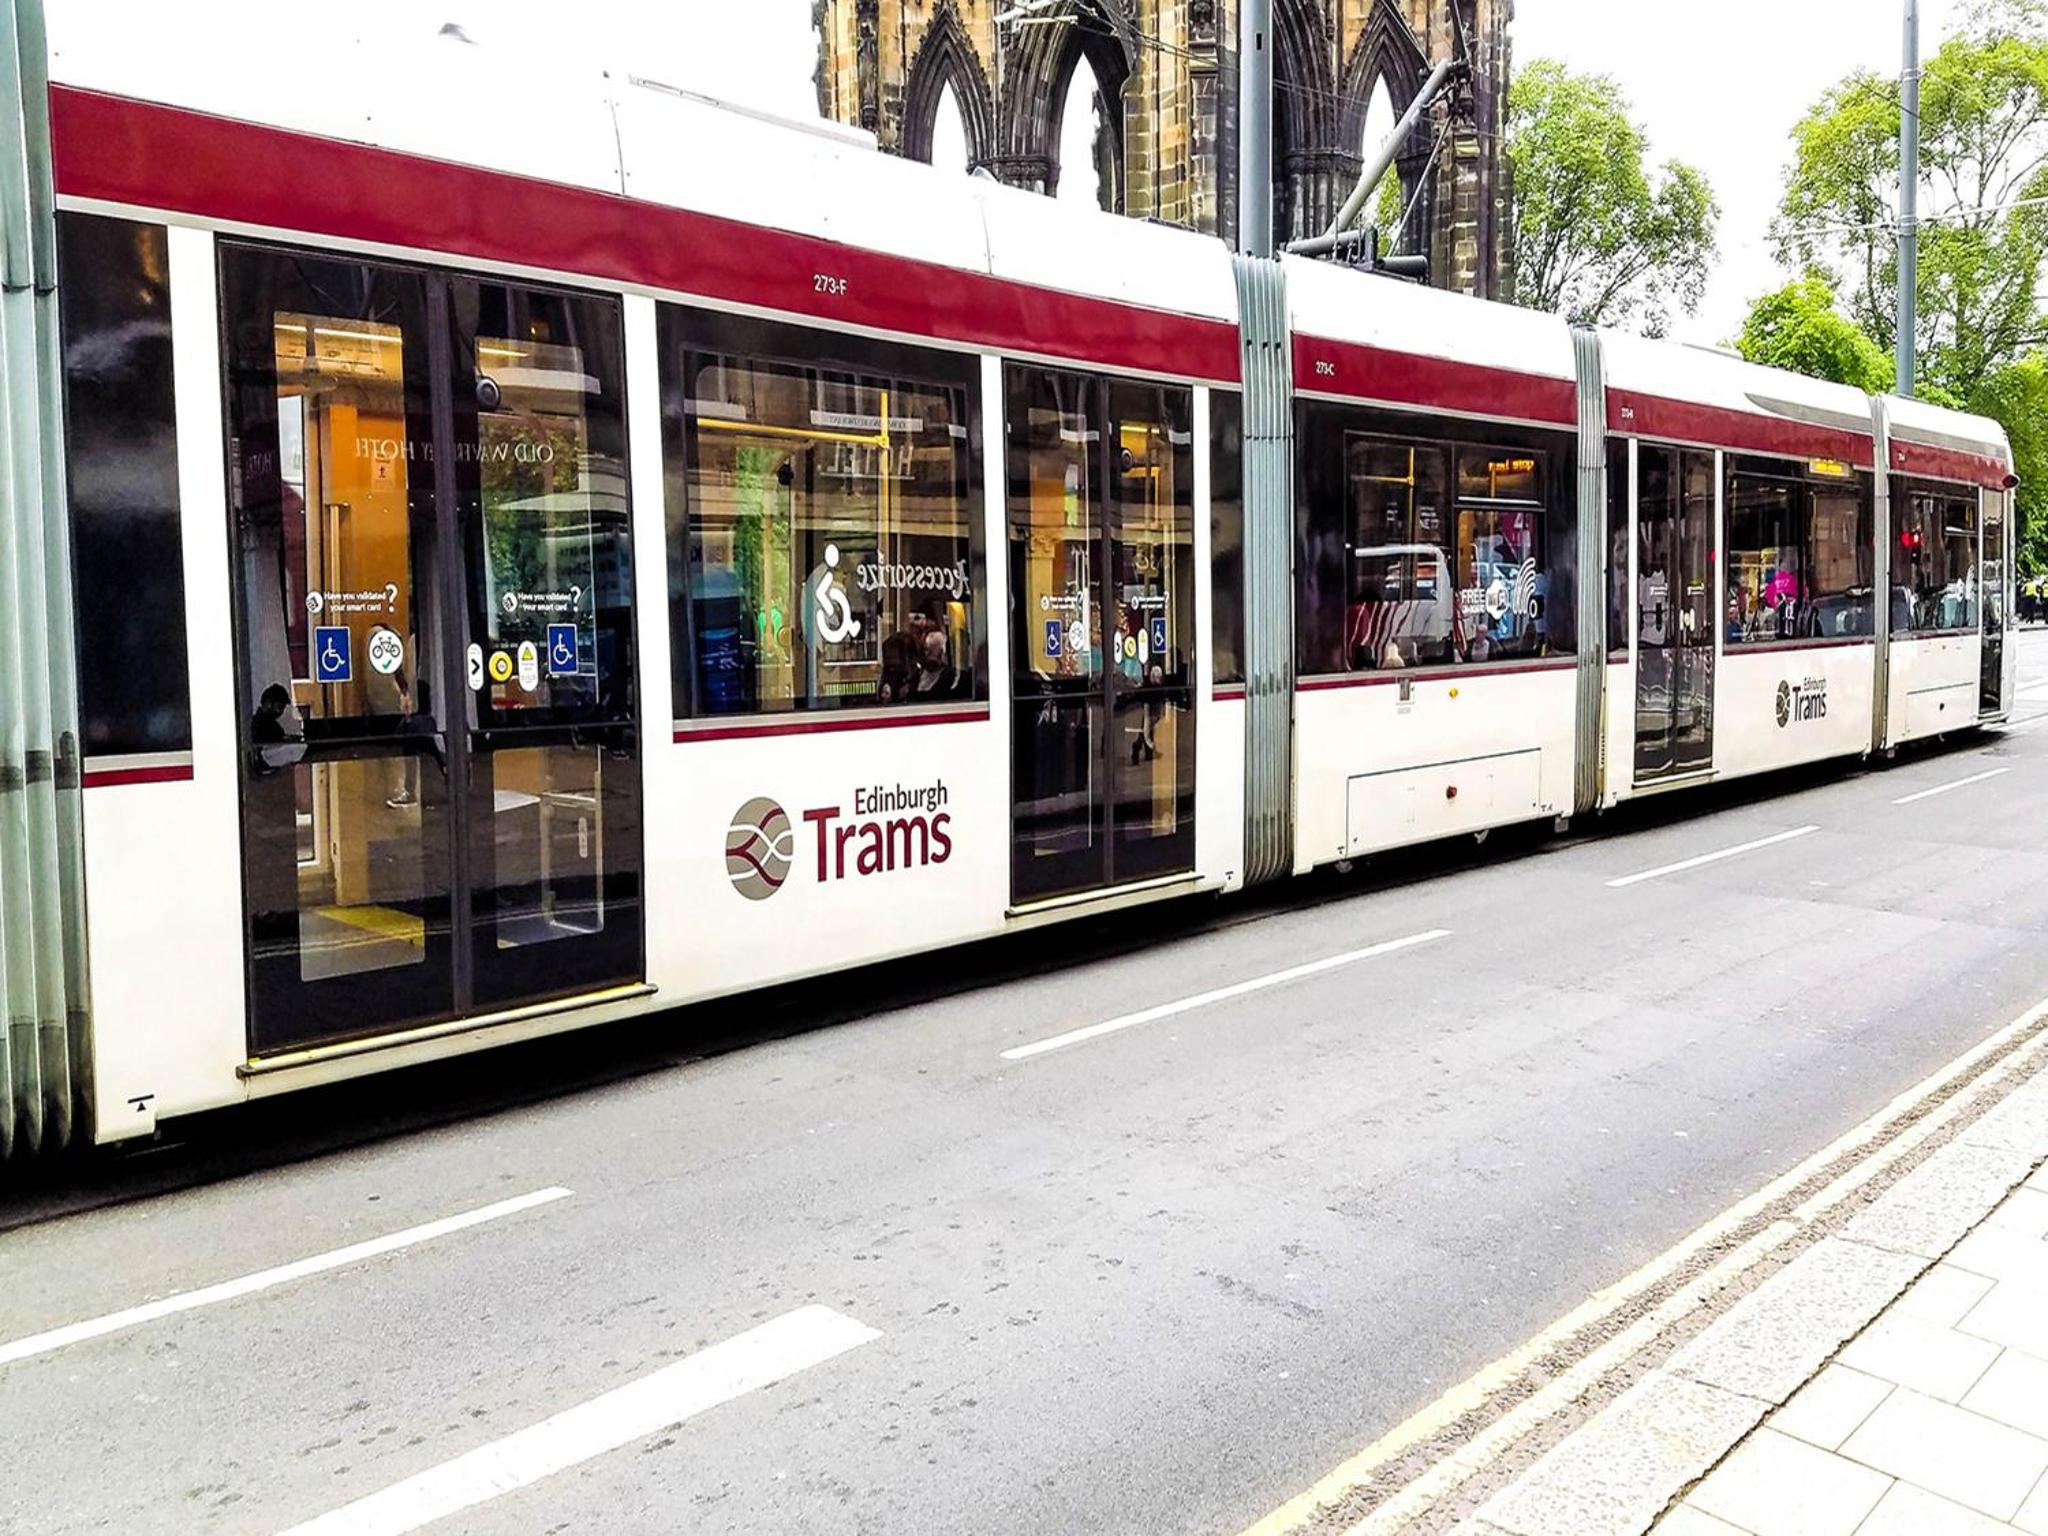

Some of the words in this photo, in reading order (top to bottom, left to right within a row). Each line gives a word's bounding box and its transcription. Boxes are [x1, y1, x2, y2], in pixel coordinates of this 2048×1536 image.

[813, 274, 848, 295] 273-F
[323, 591, 341, 600] Have
[343, 592, 355, 601] you
[357, 591, 386, 600] validated
[1461, 588, 1486, 604] FREE
[330, 604, 345, 612] your
[346, 603, 366, 611] smart
[367, 603, 382, 611] card
[1792, 686, 1827, 721] Trams
[855, 779, 948, 815] Edinburgh
[803, 806, 952, 882] Trams
